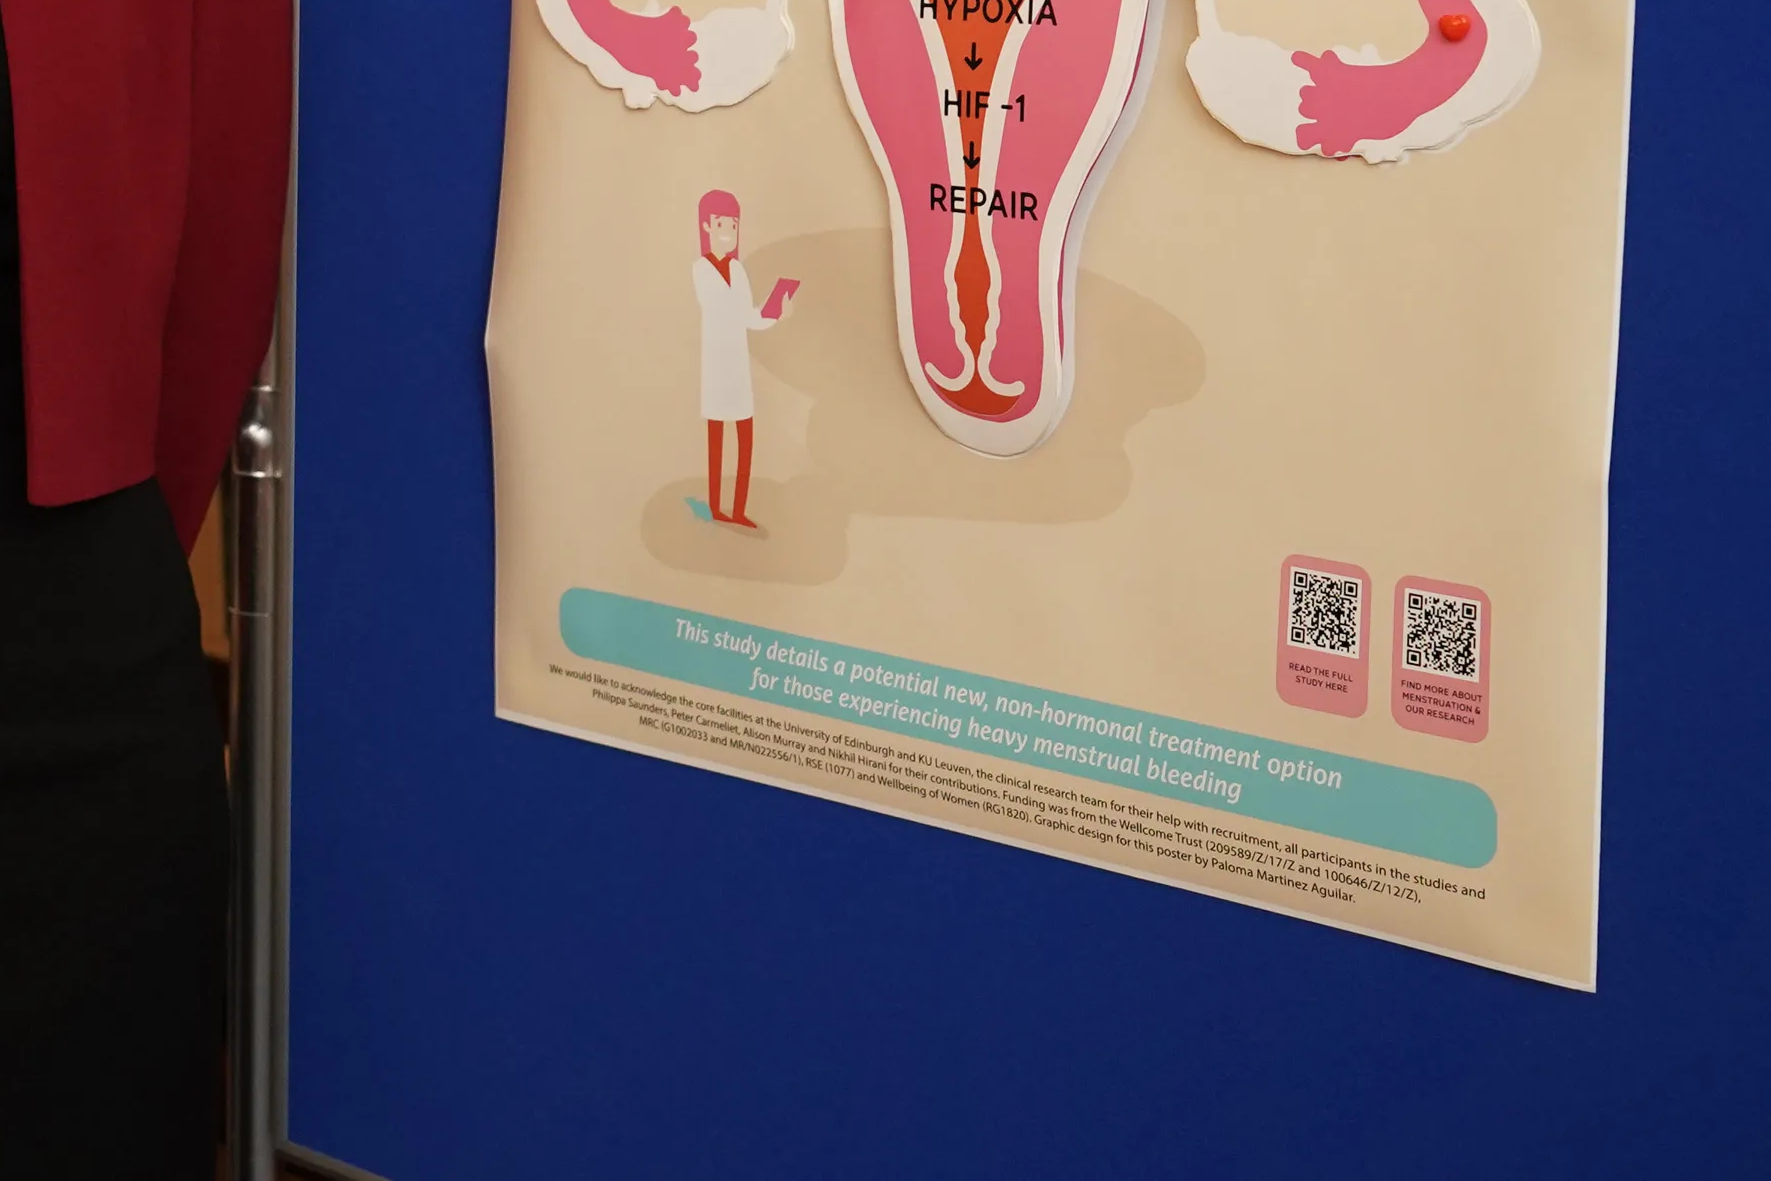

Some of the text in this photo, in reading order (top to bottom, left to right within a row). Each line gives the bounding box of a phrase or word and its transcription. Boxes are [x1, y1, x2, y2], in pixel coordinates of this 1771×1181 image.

[930, 183, 1038, 221] REPAIR
[1288, 662, 1353, 682] READ THE FULL
[1295, 675, 1347, 693] STUDY HERE
[676, 618, 1342, 789] This study details a potential new, non-hormonal treatment option
[1401, 679, 1482, 702] FIND MORE ABOUT
[1402, 691, 1480, 715] MENSTRUATION &
[1405, 704, 1474, 725] OUR RESEARCH
[749, 666, 1242, 804] for those experiencing heavy menstrual bleeding
[976, 768, 1485, 899] the clinical research team for their help with recruitment, all participants in the studies and
[1174, 831, 1202, 849] Trust
[1298, 864, 1320, 877] and
